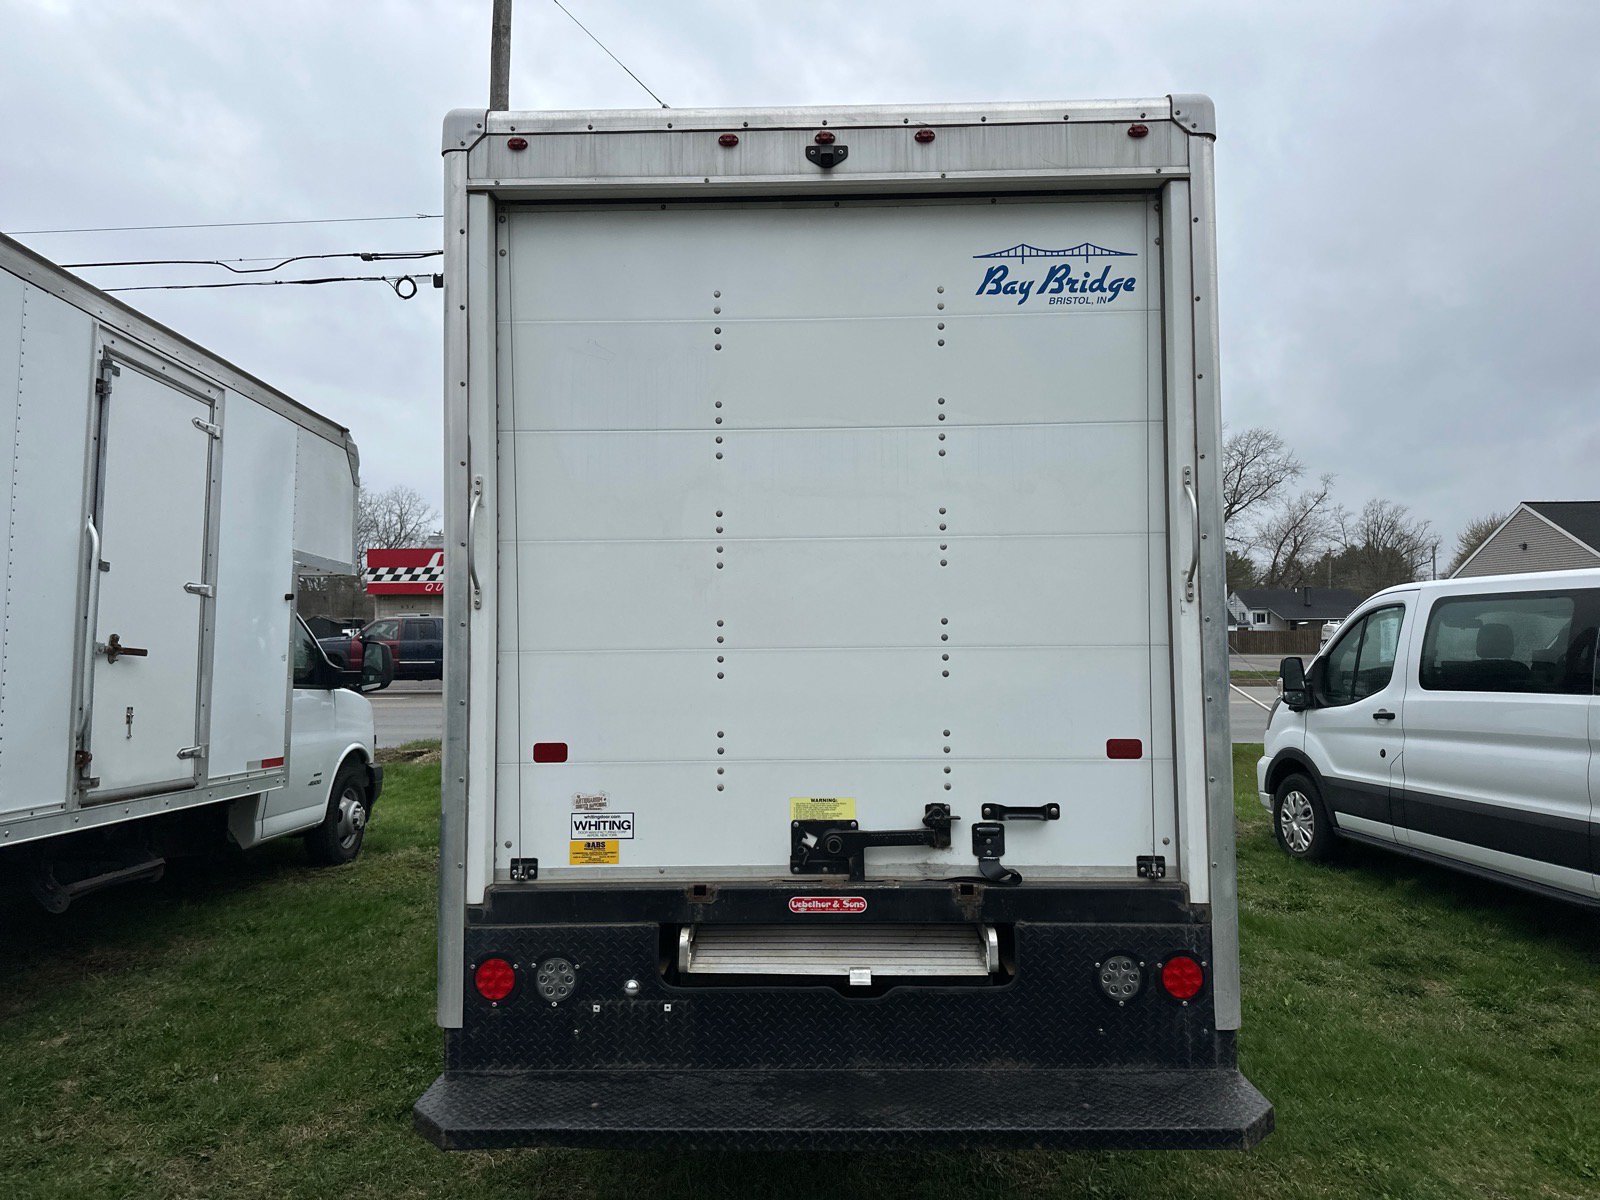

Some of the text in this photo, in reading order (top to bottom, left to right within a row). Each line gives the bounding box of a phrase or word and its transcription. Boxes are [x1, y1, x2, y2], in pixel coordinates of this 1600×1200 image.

[975, 263, 1137, 306] Bay Bridge
[1048, 296, 1108, 305] BRISTOL, IN
[574, 820, 631, 830] WHITING
[832, 899, 840, 908] &
[842, 899, 865, 908] Sons
